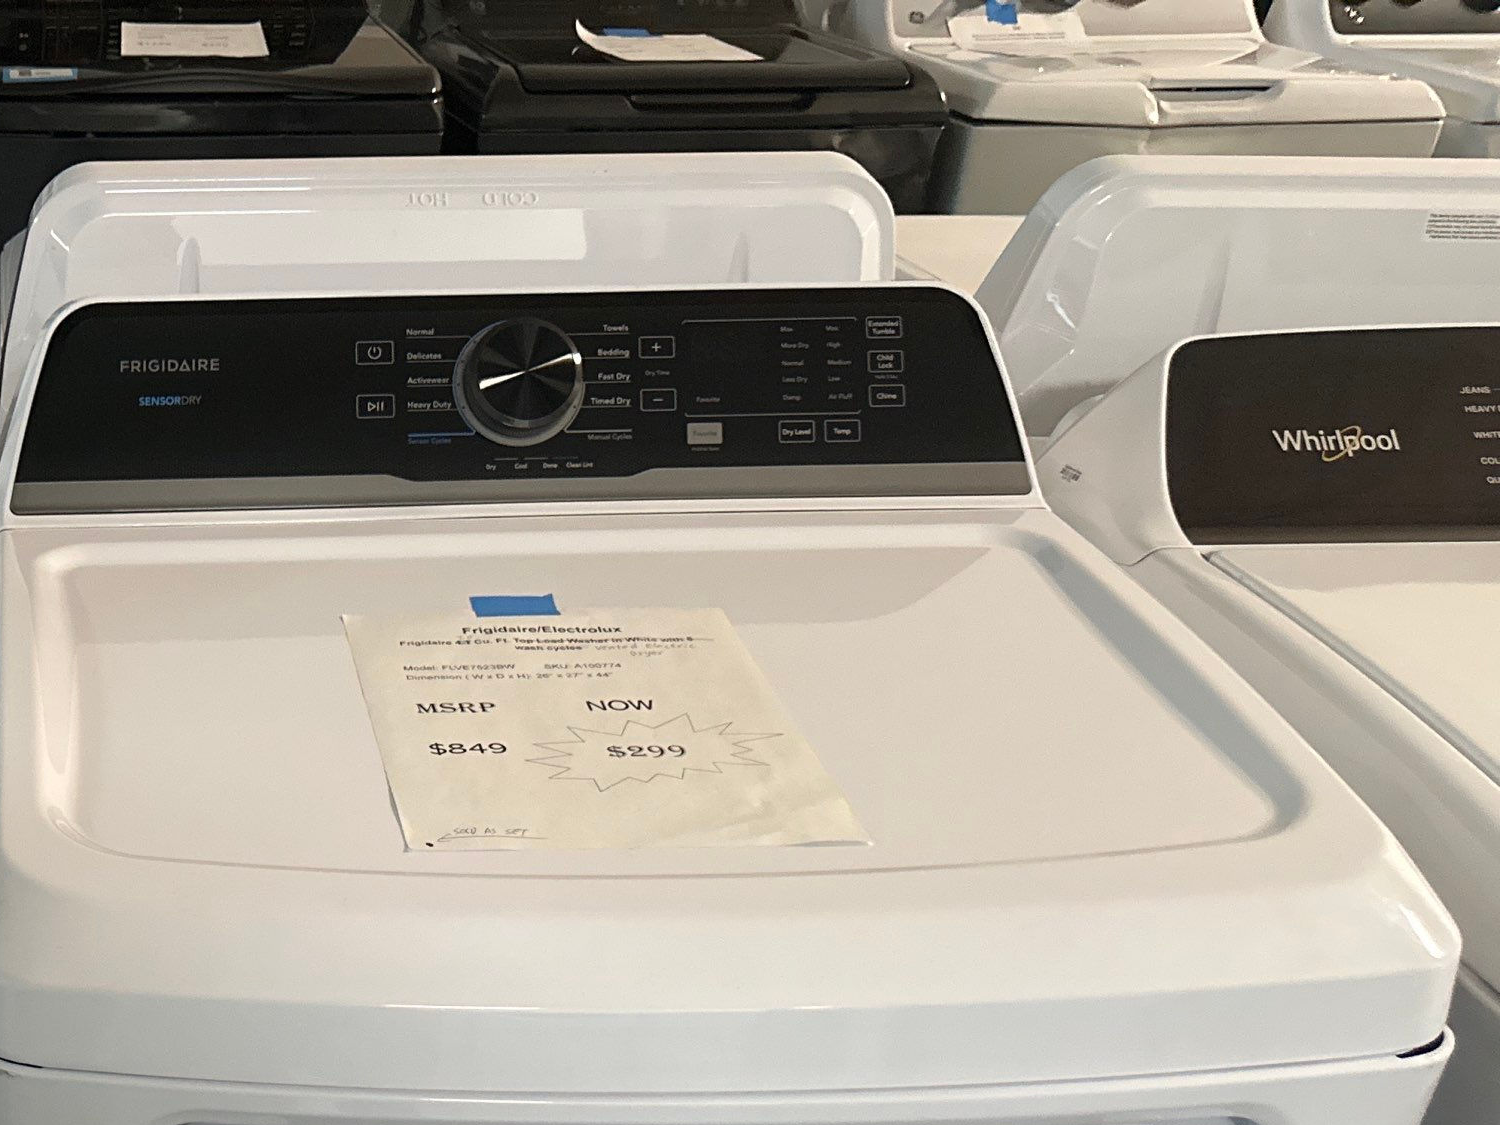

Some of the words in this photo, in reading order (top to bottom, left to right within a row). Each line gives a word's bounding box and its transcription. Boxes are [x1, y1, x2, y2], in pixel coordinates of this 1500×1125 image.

[482, 191, 539, 206] COLD
[406, 328, 435, 336] Normal
[406, 352, 442, 360] Delicates
[597, 349, 629, 358] Bedding
[120, 359, 220, 373] FRIGIDAIRE
[407, 376, 450, 385] Activewear
[616, 373, 632, 382] Dry
[1460, 386, 1491, 394] JEANS
[139, 395, 202, 406] SENSORDRY
[590, 397, 615, 405] Timed
[616, 397, 632, 407] Dry
[407, 401, 431, 410] Heavy
[432, 401, 452, 410] Duty
[1464, 405, 1496, 413] HEAVY
[782, 428, 793, 436] Dry
[794, 427, 811, 435] Level
[1271, 428, 1400, 457] Whirlpool
[462, 625, 622, 636] Frigidaire/Electrolux
[399, 639, 452, 647] Frigidaire
[547, 644, 585, 652] cycles
[416, 702, 497, 715] MSRP
[585, 699, 654, 713] NOW
[429, 741, 508, 757] $849
[606, 744, 689, 759] $299
